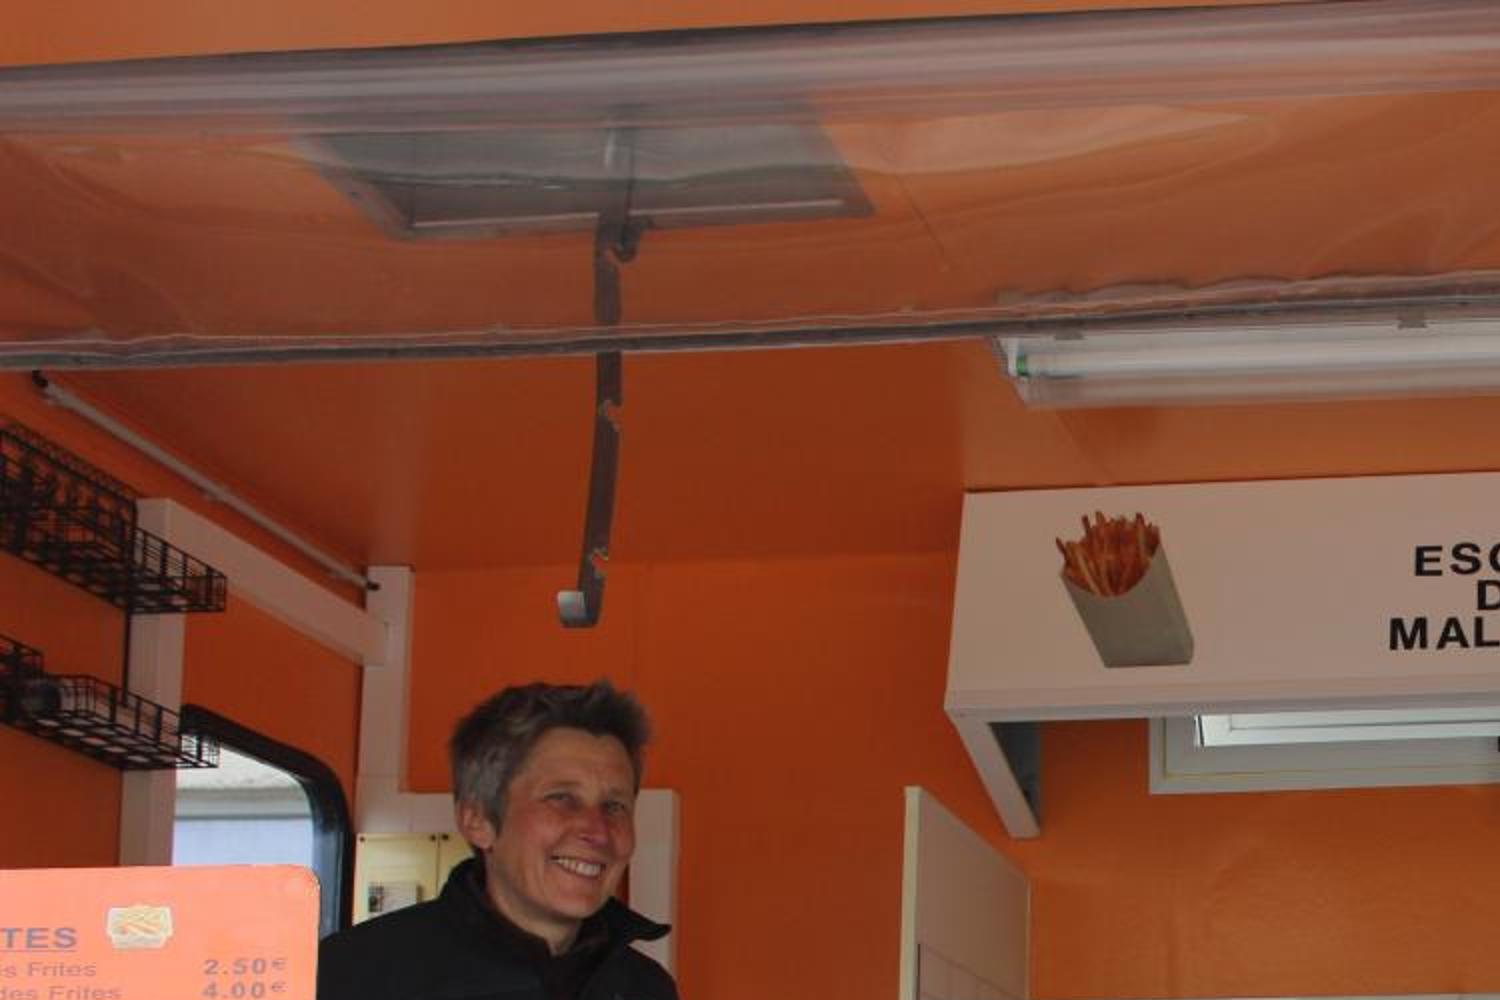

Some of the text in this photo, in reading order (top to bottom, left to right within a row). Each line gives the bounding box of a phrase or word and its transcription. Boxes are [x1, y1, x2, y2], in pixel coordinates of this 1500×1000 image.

[28, 962, 96, 977] Frites
[204, 958, 287, 975] 2.50€
[49, 985, 122, 1000] Frites
[203, 981, 287, 999] 4.00€
